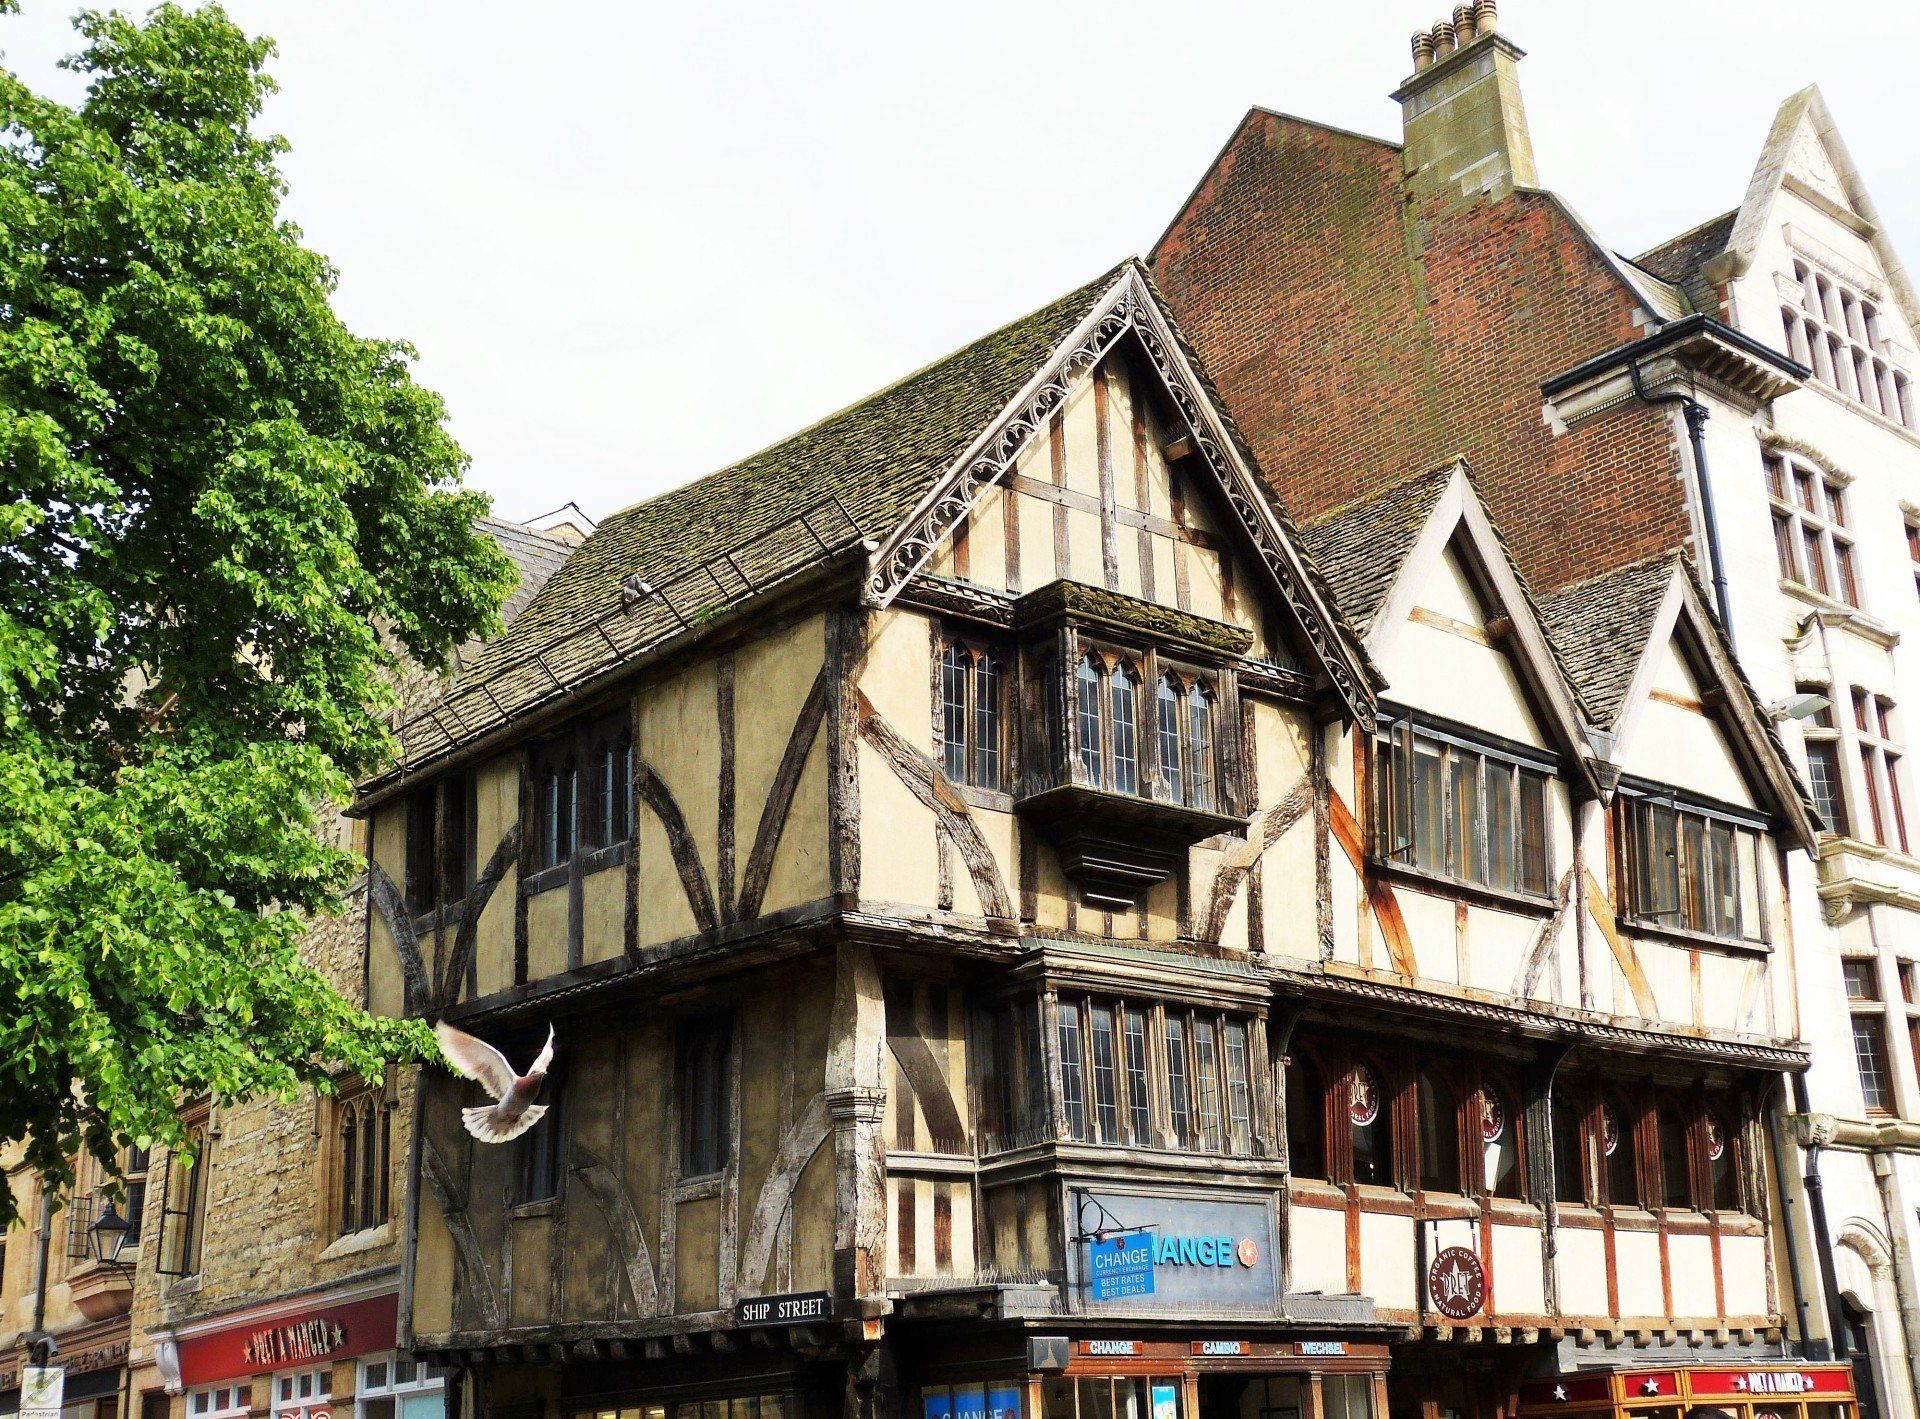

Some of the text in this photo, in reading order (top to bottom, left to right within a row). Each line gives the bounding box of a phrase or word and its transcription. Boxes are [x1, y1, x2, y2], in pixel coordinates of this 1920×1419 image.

[1095, 1248, 1149, 1269] CHANGE
[1431, 1249, 1481, 1282] ORGANIC COFFEE
[1101, 1273, 1145, 1287] BEST RATES
[1101, 1283, 1146, 1298] BEST DEALS
[1442, 1271, 1471, 1297] PRET
[743, 1298, 824, 1321] SHIP STREET
[1434, 1291, 1481, 1317] NATURAL FOOD
[287, 1319, 331, 1361] MANGER
[1090, 1340, 1346, 1355] CHANGE CAMBIO WECHSEL
